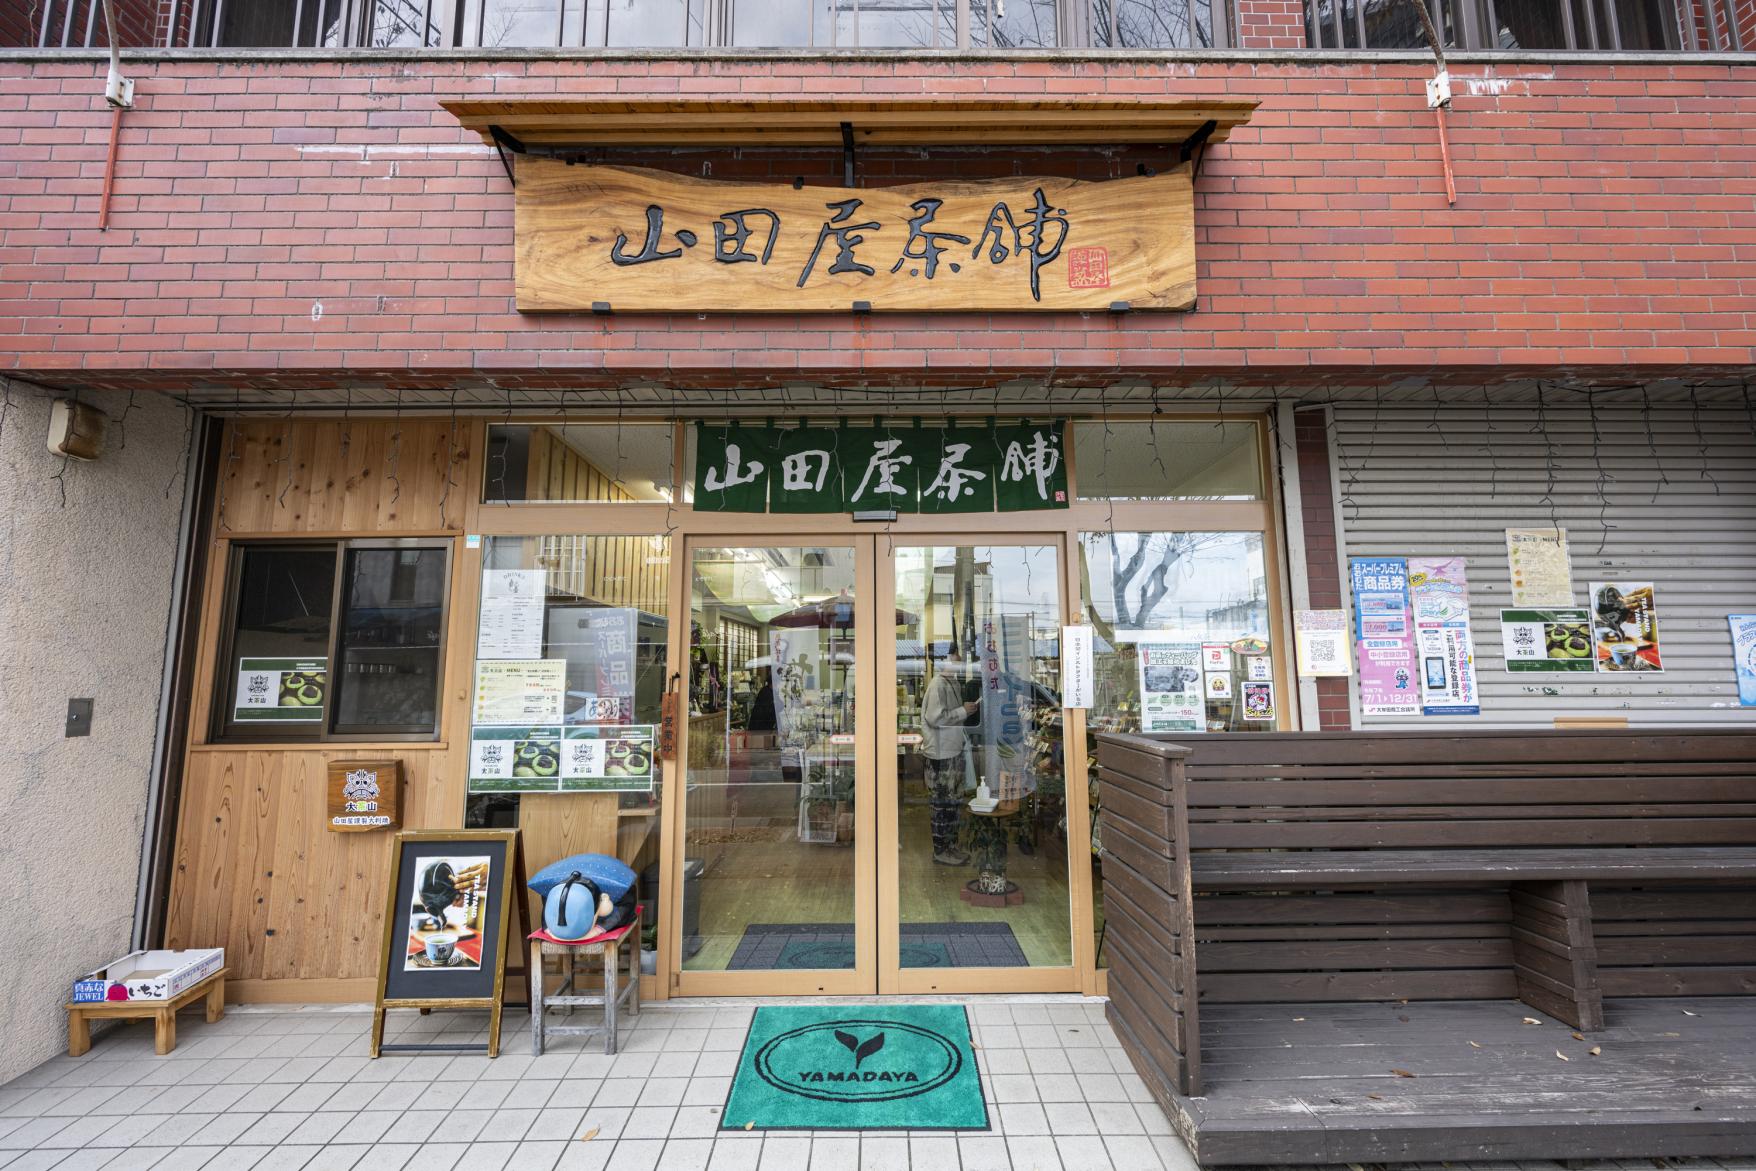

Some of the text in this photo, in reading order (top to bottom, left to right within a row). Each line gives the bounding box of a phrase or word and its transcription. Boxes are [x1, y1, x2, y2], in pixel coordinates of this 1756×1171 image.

[1361, 562, 1404, 575] スーパープレミアム
[1363, 575, 1405, 591] 商品券
[247, 696, 267, 704] 大茶山
[573, 766, 592, 774] 大茶山
[345, 801, 377, 811] 大茶山
[128, 984, 166, 998] いちご
[74, 993, 104, 1001] JEWEL
[799, 1071, 919, 1083] YAMADAYA
